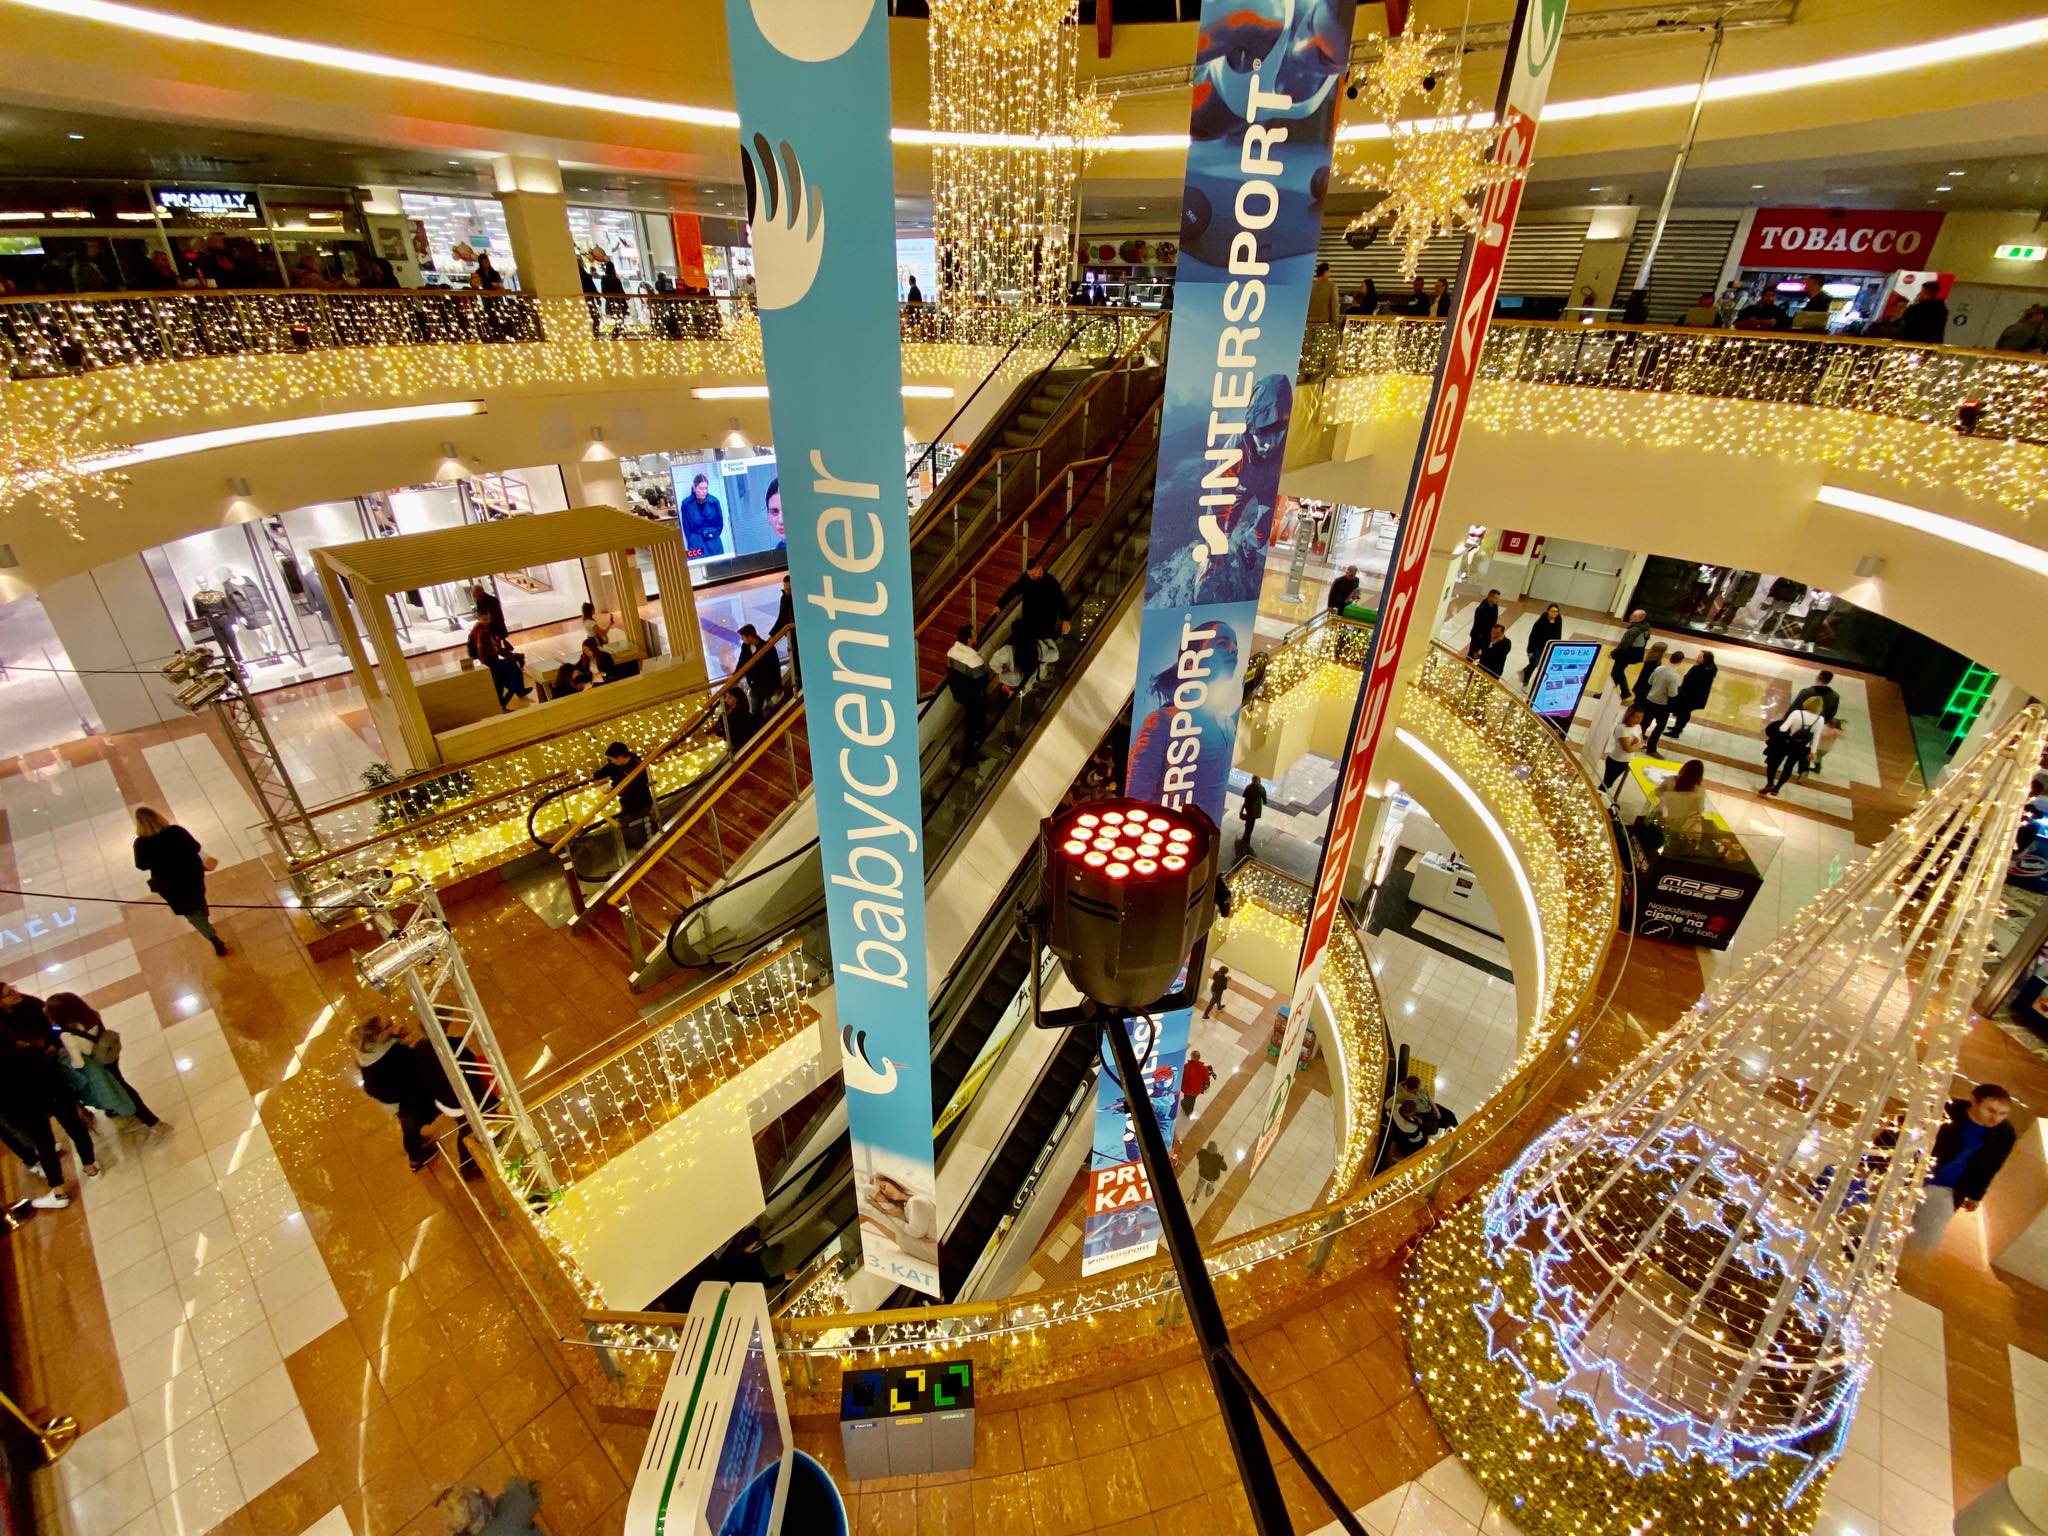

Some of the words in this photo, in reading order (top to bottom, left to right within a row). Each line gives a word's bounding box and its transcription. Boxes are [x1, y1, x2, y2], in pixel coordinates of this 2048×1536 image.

[160, 192, 247, 208] PICADILLY
[1760, 226, 1921, 254] TOBACCO
[1198, 73, 1293, 507] INTERSPORT
[687, 548, 703, 557] CCC
[808, 448, 918, 989] babycenter
[1161, 621, 1217, 813] ERSPORT
[1657, 883, 1717, 901] SHOES
[1662, 876, 1741, 898] MASS
[1644, 909, 1684, 924] cipele
[1686, 917, 1704, 928] na
[868, 1254, 886, 1270] 3.
[891, 1262, 934, 1286] KAT
